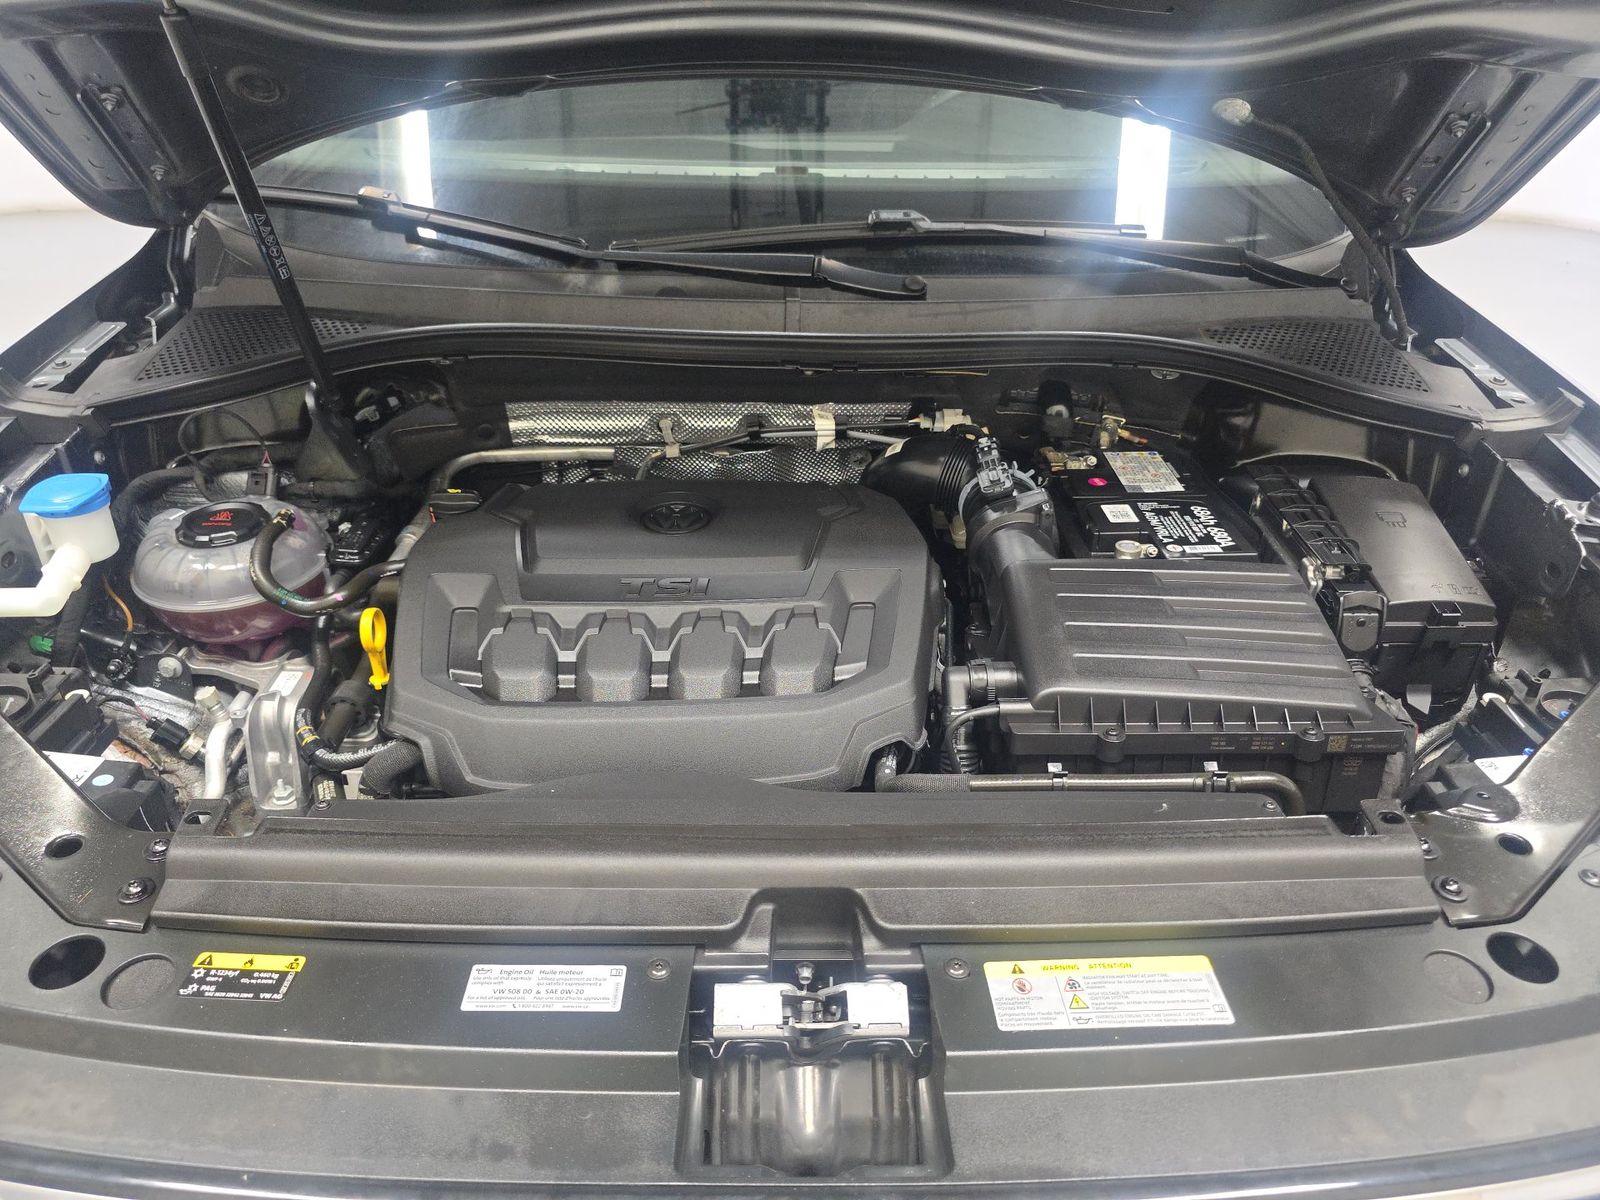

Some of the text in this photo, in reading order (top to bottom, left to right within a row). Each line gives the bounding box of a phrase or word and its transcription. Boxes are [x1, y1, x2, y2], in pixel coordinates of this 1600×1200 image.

[1190, 505, 1218, 526] 68Ah
[1206, 526, 1236, 547] 680A
[620, 577, 711, 598] TSI
